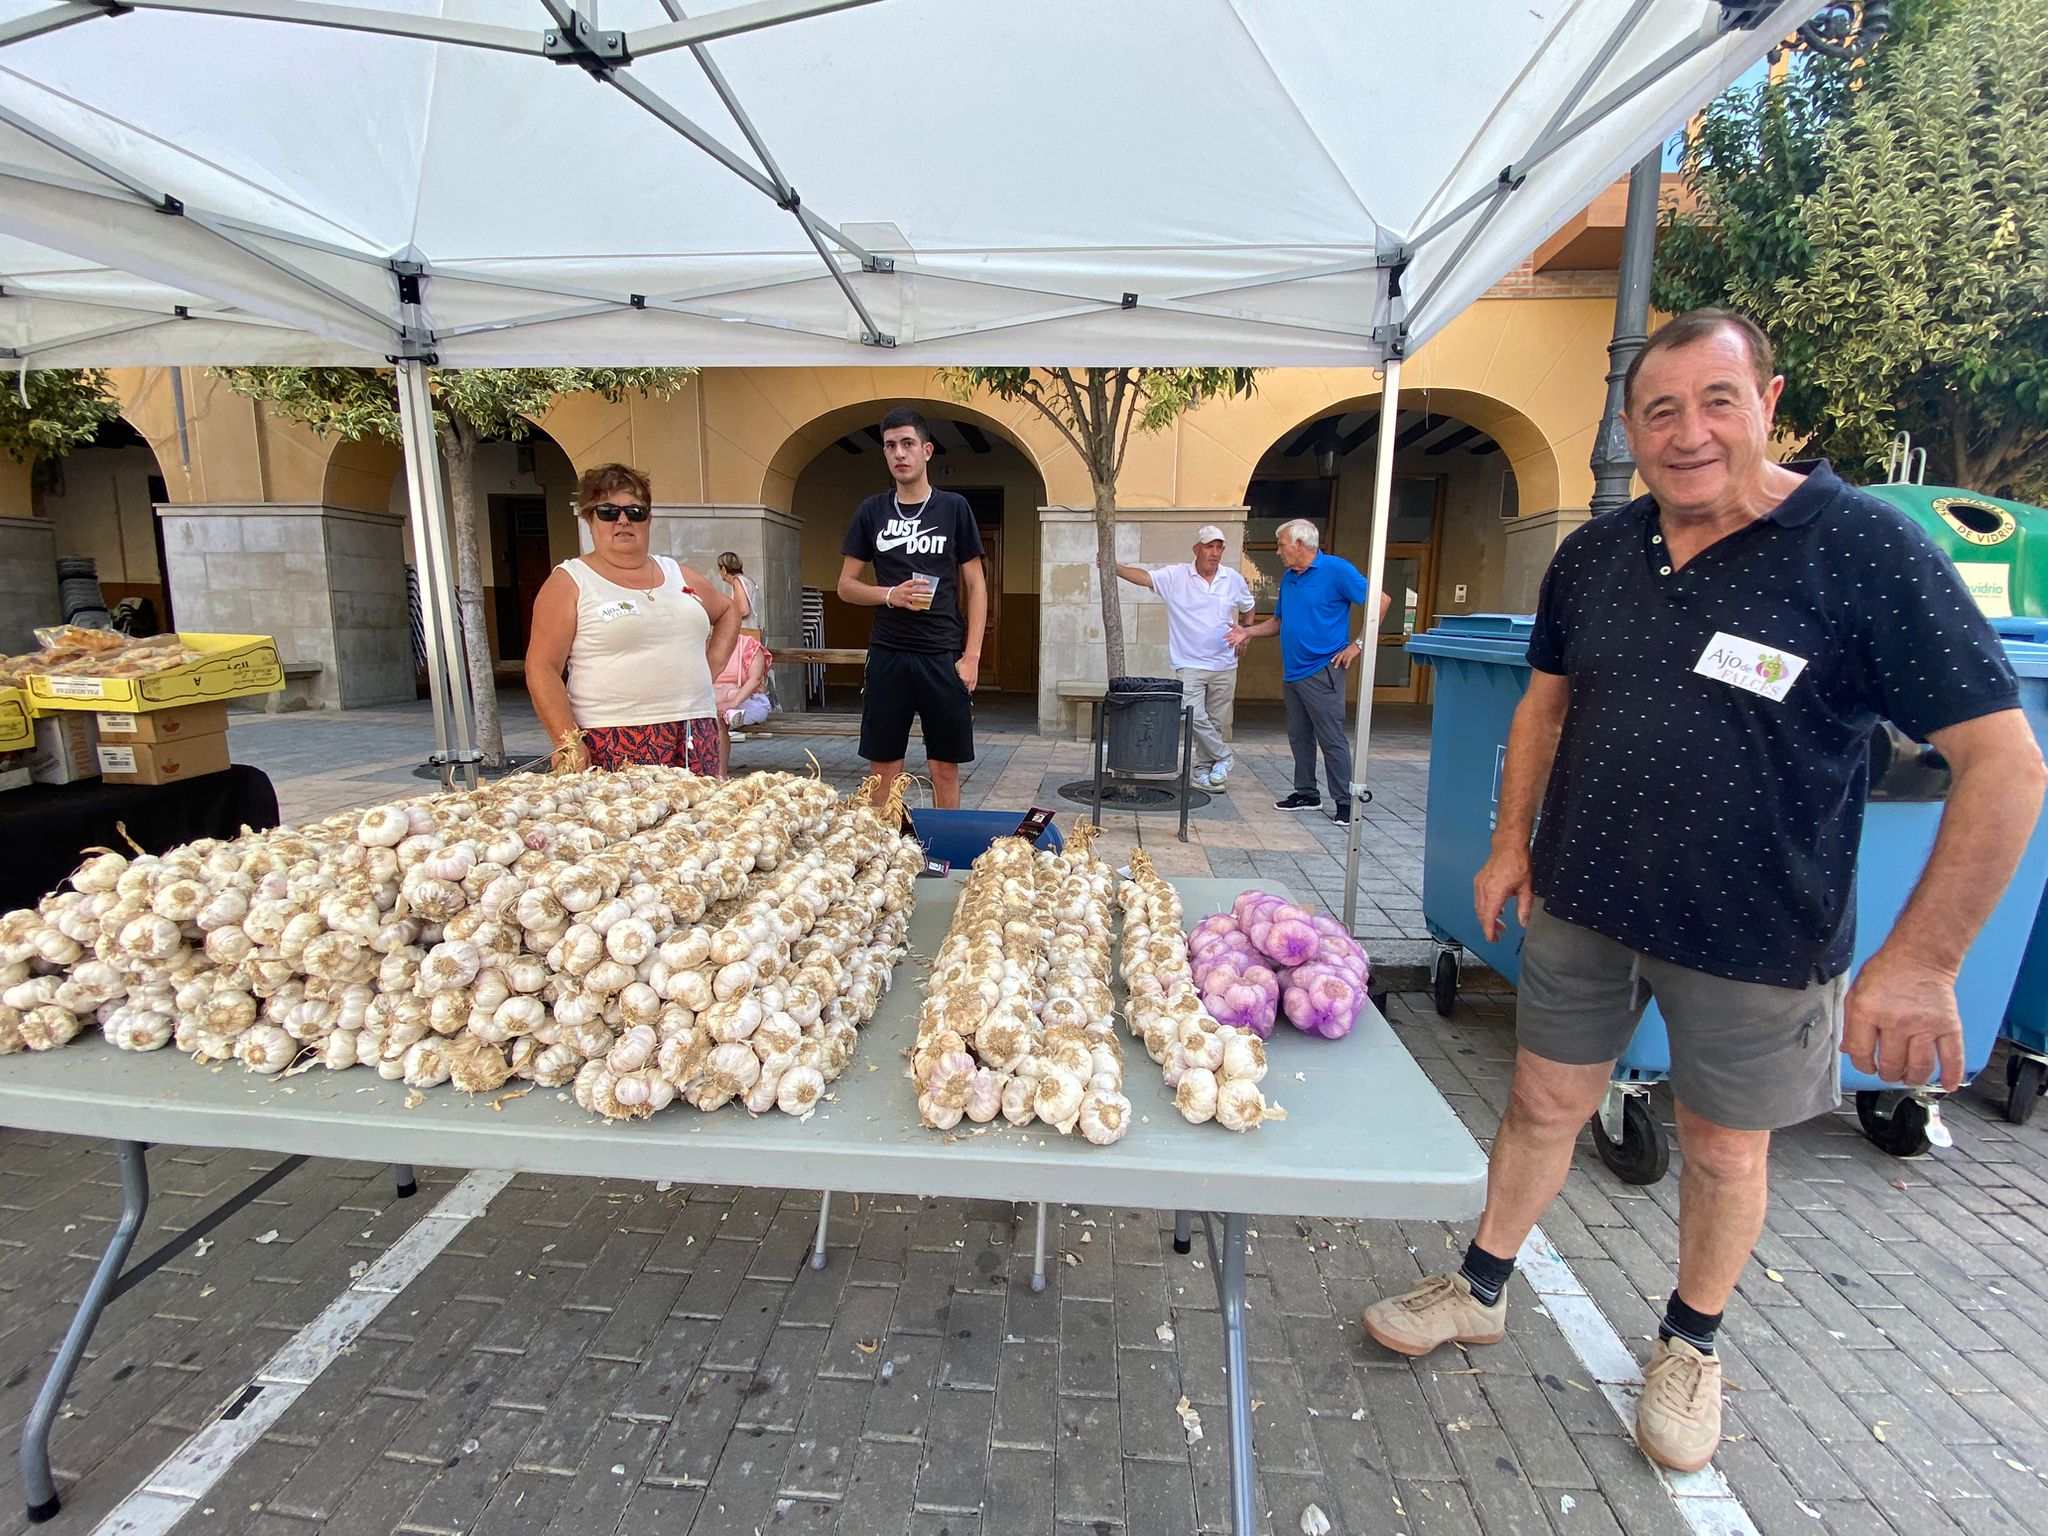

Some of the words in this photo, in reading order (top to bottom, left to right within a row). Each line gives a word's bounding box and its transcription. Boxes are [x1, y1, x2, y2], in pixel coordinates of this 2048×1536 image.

[883, 520, 921, 537] JUST
[1957, 525, 1972, 539] DE
[1977, 522, 2014, 543] VIDRIO
[1970, 582, 2003, 594] vidrio
[601, 606, 615, 617] Ajo
[1708, 648, 1742, 669] Ajo
[1740, 662, 1752, 672] de
[1721, 669, 1780, 696] FALCES
[56, 688, 99, 696] PALMERITAS
